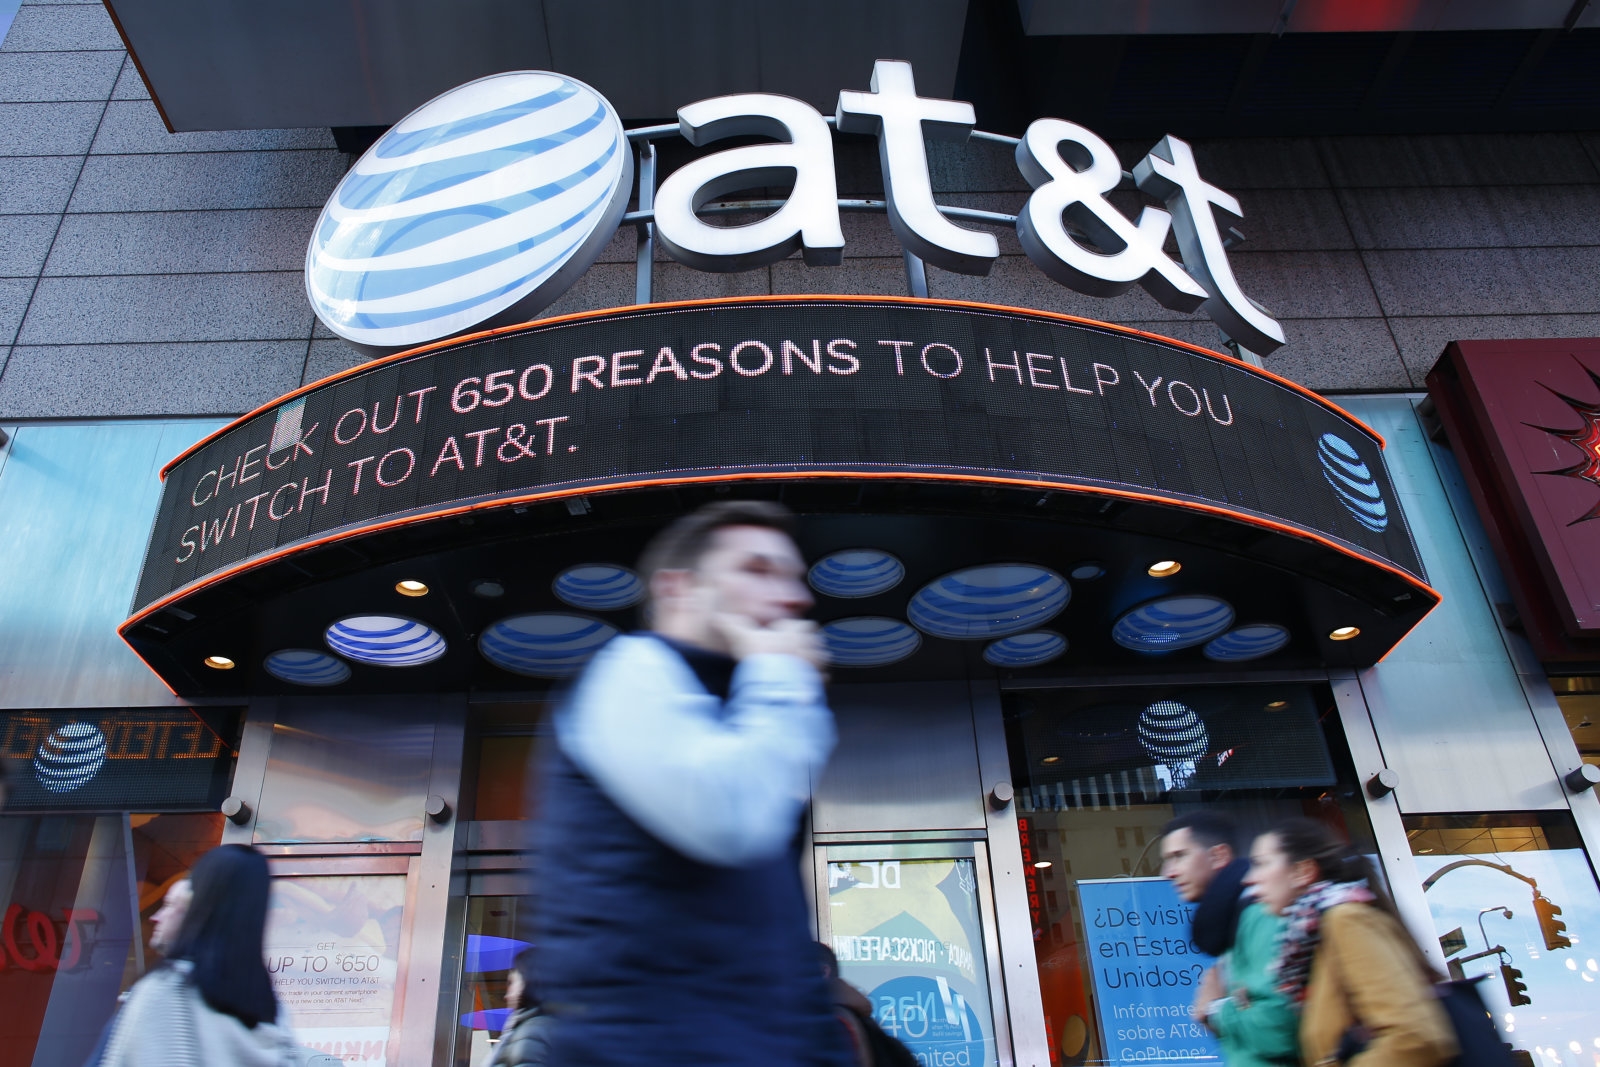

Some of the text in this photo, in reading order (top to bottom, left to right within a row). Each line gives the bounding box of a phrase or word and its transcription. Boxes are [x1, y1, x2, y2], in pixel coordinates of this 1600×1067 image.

[654, 59, 1286, 354] at&t
[334, 386, 437, 445] OUT
[451, 363, 553, 414] 650
[570, 338, 861, 394] REASONS
[877, 340, 963, 380] TO
[985, 347, 1120, 396] HELP
[1133, 370, 1234, 427] YOU
[175, 415, 579, 564] SWITCH TO AT&T.
[1094, 904, 1194, 929] ¿De visit
[316, 942, 336, 951] GET
[1099, 935, 1201, 959] en Esta
[267, 953, 380, 974] UP TO $650
[274, 976, 380, 986] HELP YOU SWITCH TO AT&T
[1104, 964, 1204, 989] Unidos?
[1117, 1023, 1166, 1041] sobre
[910, 1045, 971, 1066] mited
